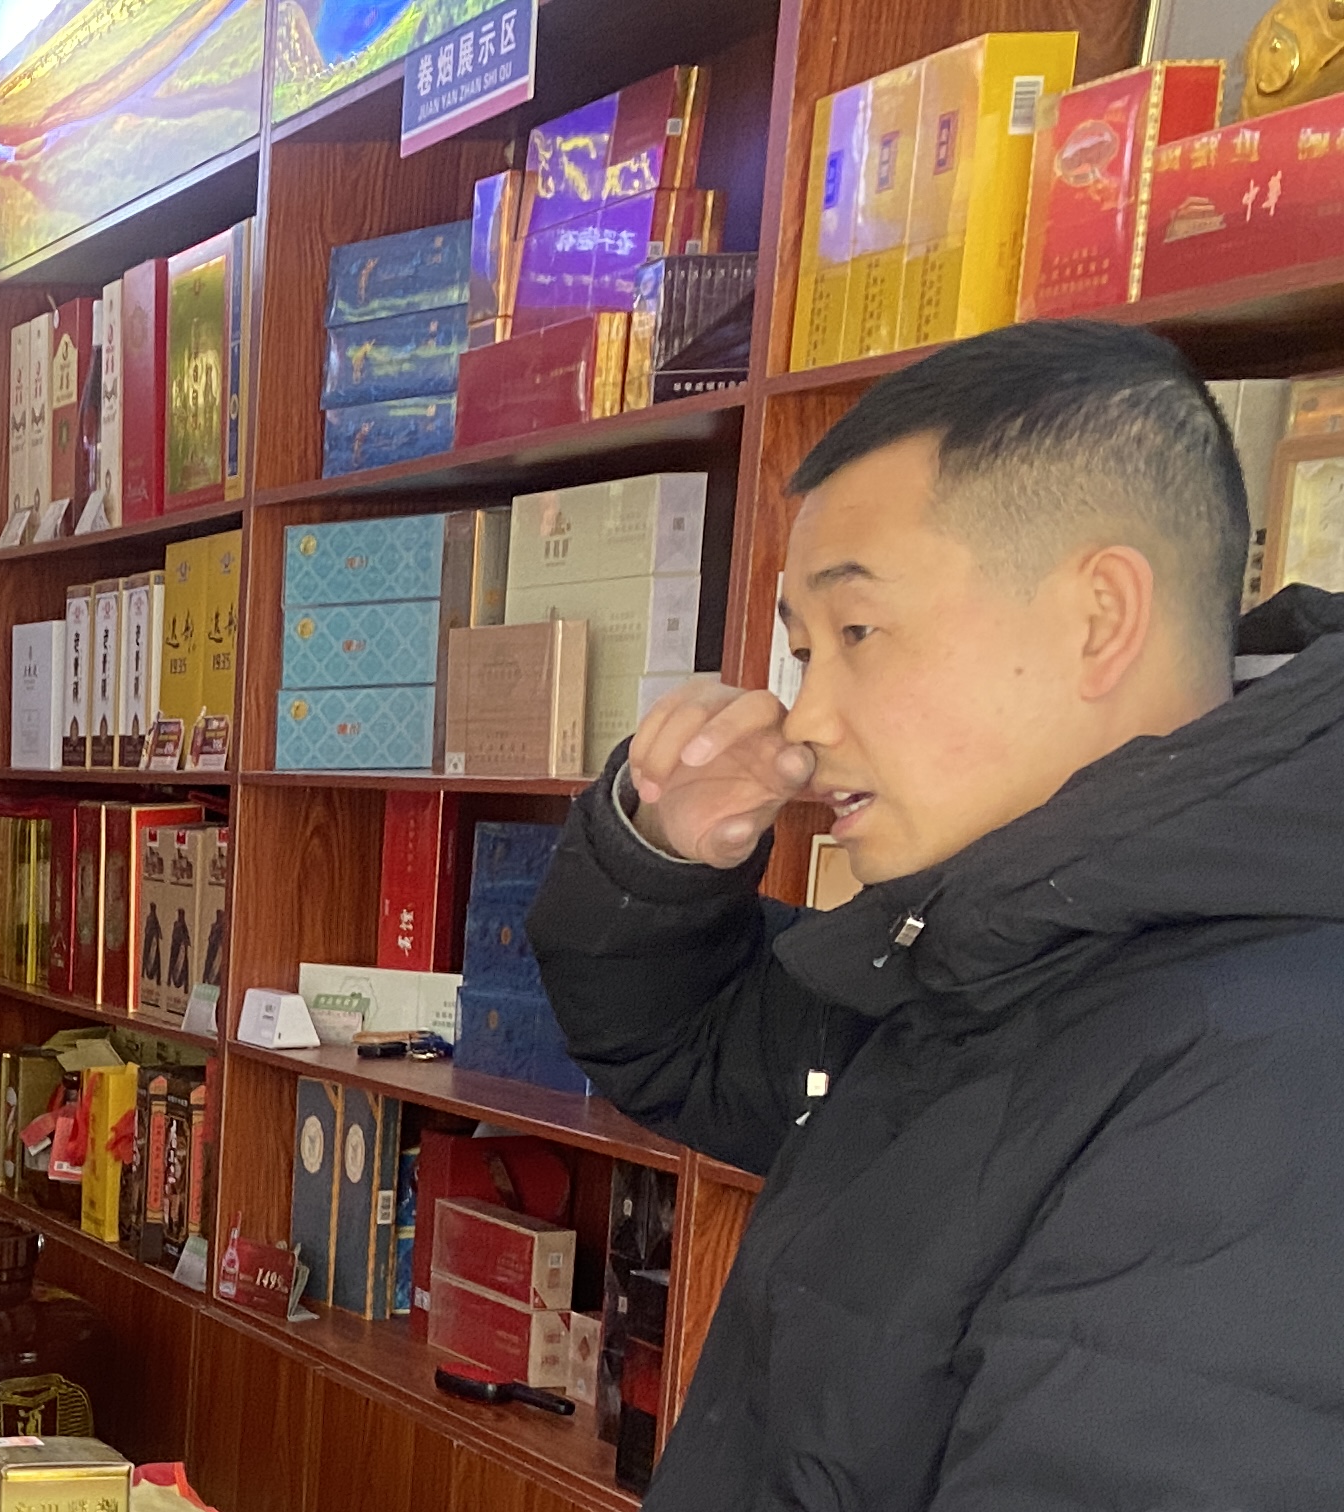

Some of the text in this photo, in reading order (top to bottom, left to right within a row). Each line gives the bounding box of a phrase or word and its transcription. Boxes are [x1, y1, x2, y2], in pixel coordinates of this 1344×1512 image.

[417, 9, 517, 96] 卷烟展示区
[441, 88, 458, 109] YAN
[459, 78, 482, 102] ZHAN
[483, 70, 498, 90] SHI
